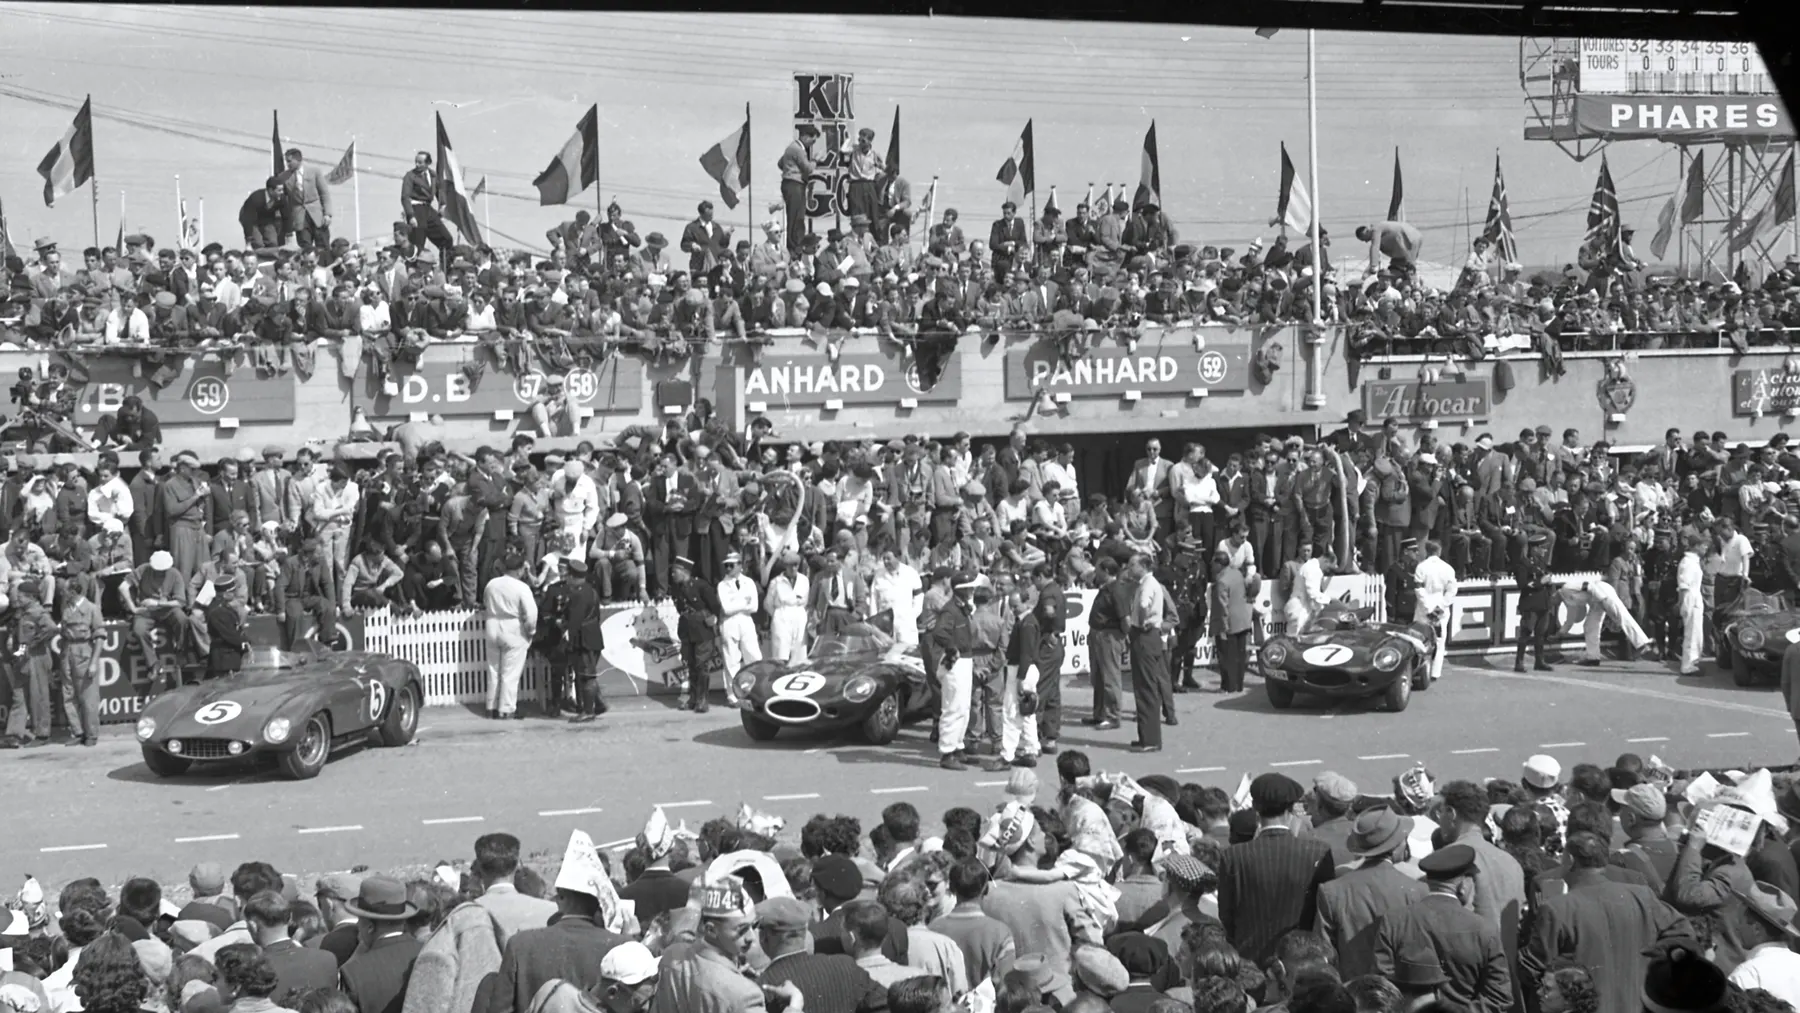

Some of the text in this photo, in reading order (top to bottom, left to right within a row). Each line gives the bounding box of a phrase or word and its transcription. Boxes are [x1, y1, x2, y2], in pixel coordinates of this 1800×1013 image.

[1583, 39, 1749, 54] VOITURES 32 33 34 35 36
[1587, 54, 1619, 70] TOURS
[1643, 57, 1650, 70] 0
[1668, 57, 1675, 71] 0
[1718, 58, 1725, 72] 0
[1742, 58, 1749, 72] 0
[1611, 103, 1779, 129] PHARES
[1033, 356, 1222, 385] PANHARD 52
[196, 382, 221, 407] 59
[520, 374, 541, 398] 57
[569, 372, 593, 397] 58
[1377, 384, 1481, 418] Autocar
[1320, 647, 1343, 662] 7
[785, 673, 815, 691] 6
[202, 703, 234, 724] 5
